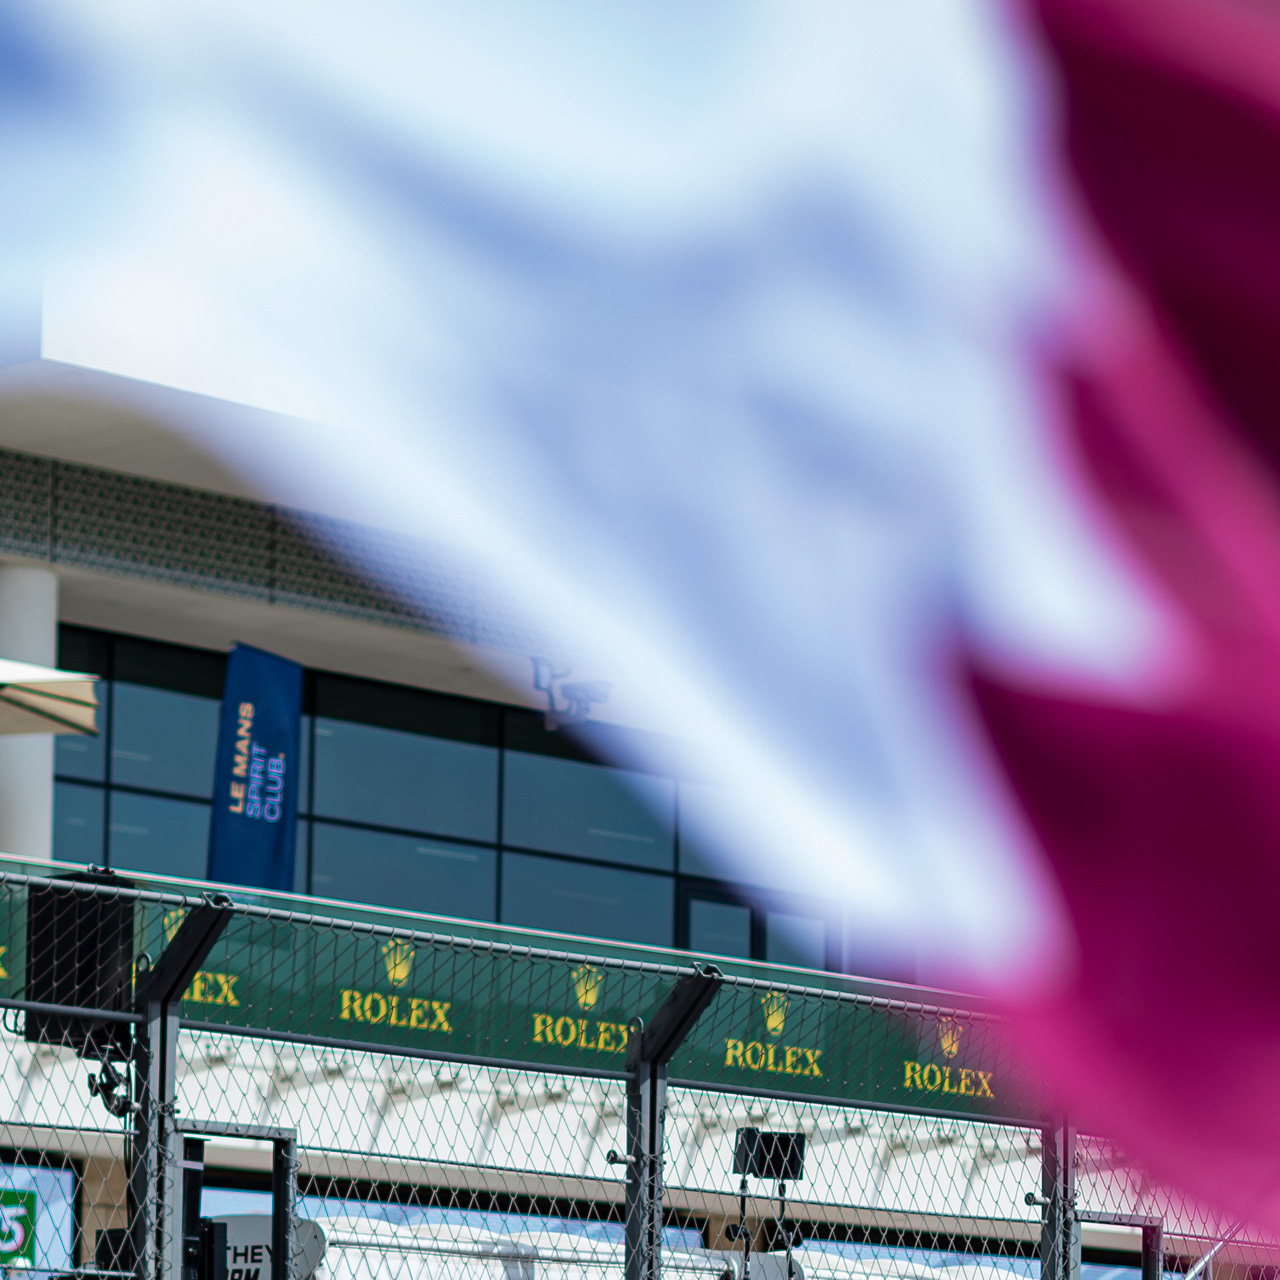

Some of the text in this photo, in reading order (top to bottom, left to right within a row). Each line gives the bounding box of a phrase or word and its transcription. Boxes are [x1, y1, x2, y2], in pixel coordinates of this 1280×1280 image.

[229, 702, 255, 814] LE MANS
[245, 741, 268, 819] SPIRIT
[338, 988, 454, 1033] ROLEX
[724, 1038, 824, 1078] ROLEX
[903, 1060, 996, 1099] ROLEX
